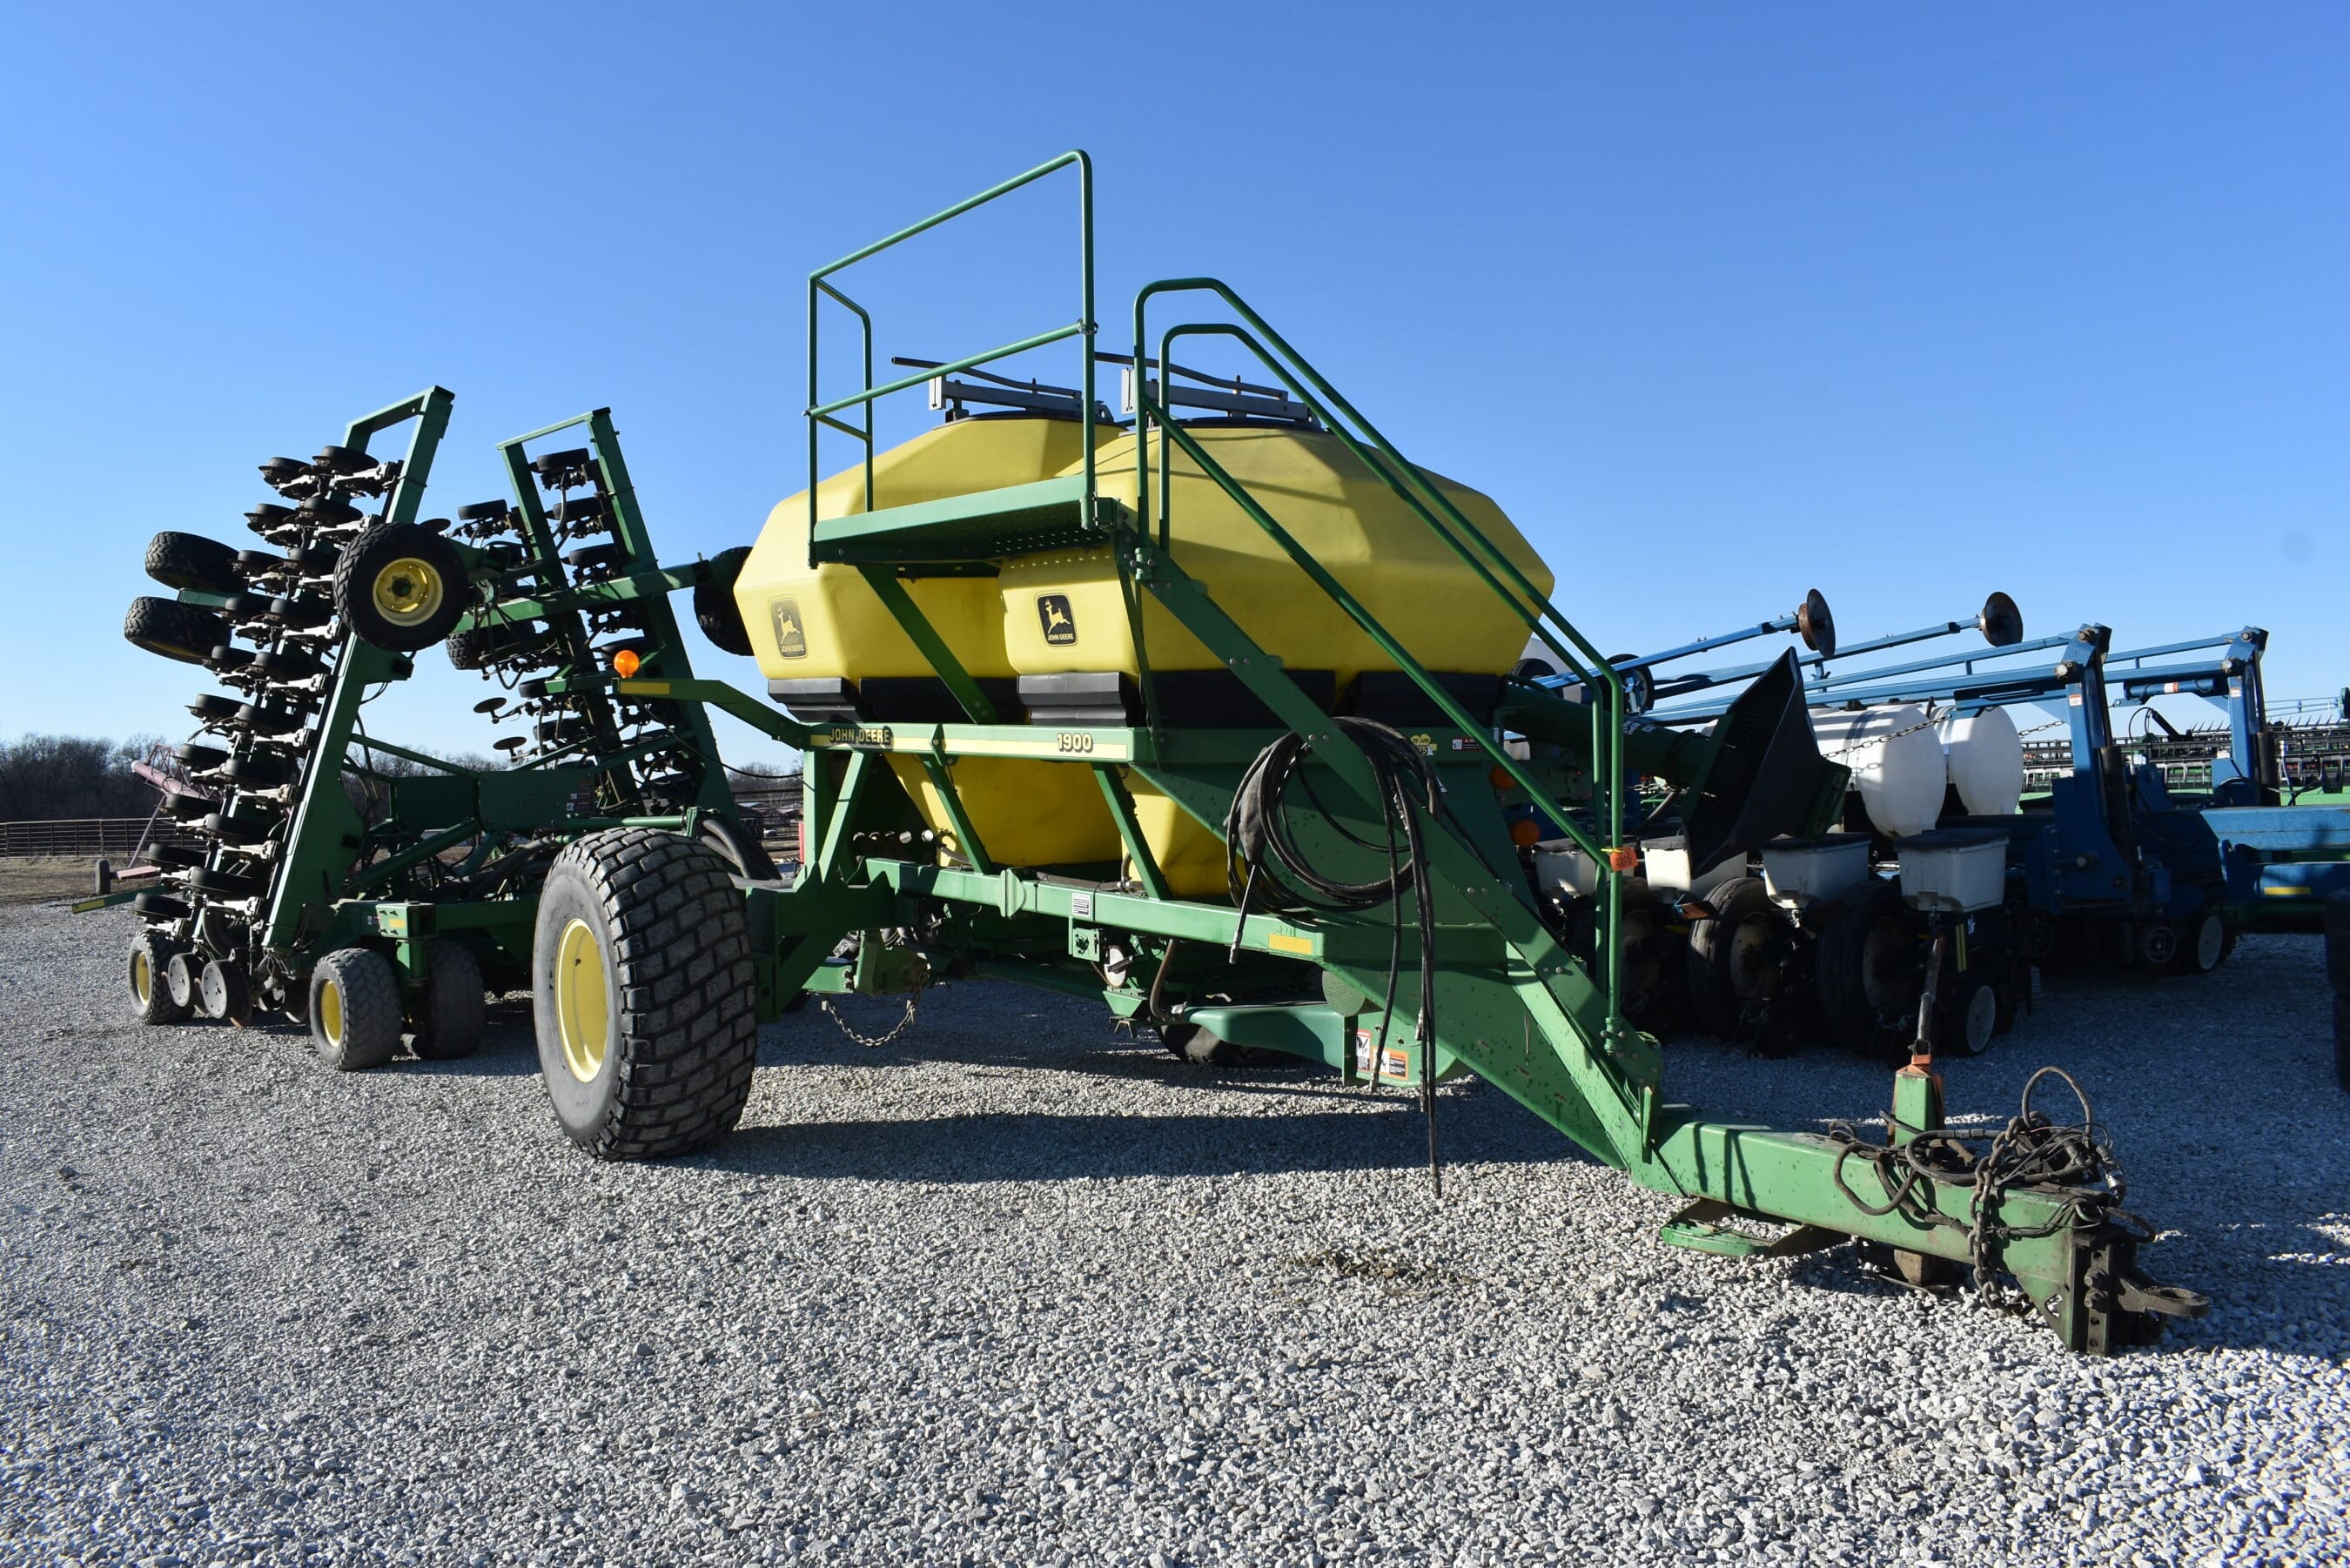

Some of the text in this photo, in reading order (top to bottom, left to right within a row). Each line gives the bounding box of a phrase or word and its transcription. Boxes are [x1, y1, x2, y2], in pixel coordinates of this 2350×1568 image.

[829, 728, 890, 745] JOHN DEERE
[1057, 732, 1093, 754] 1900
